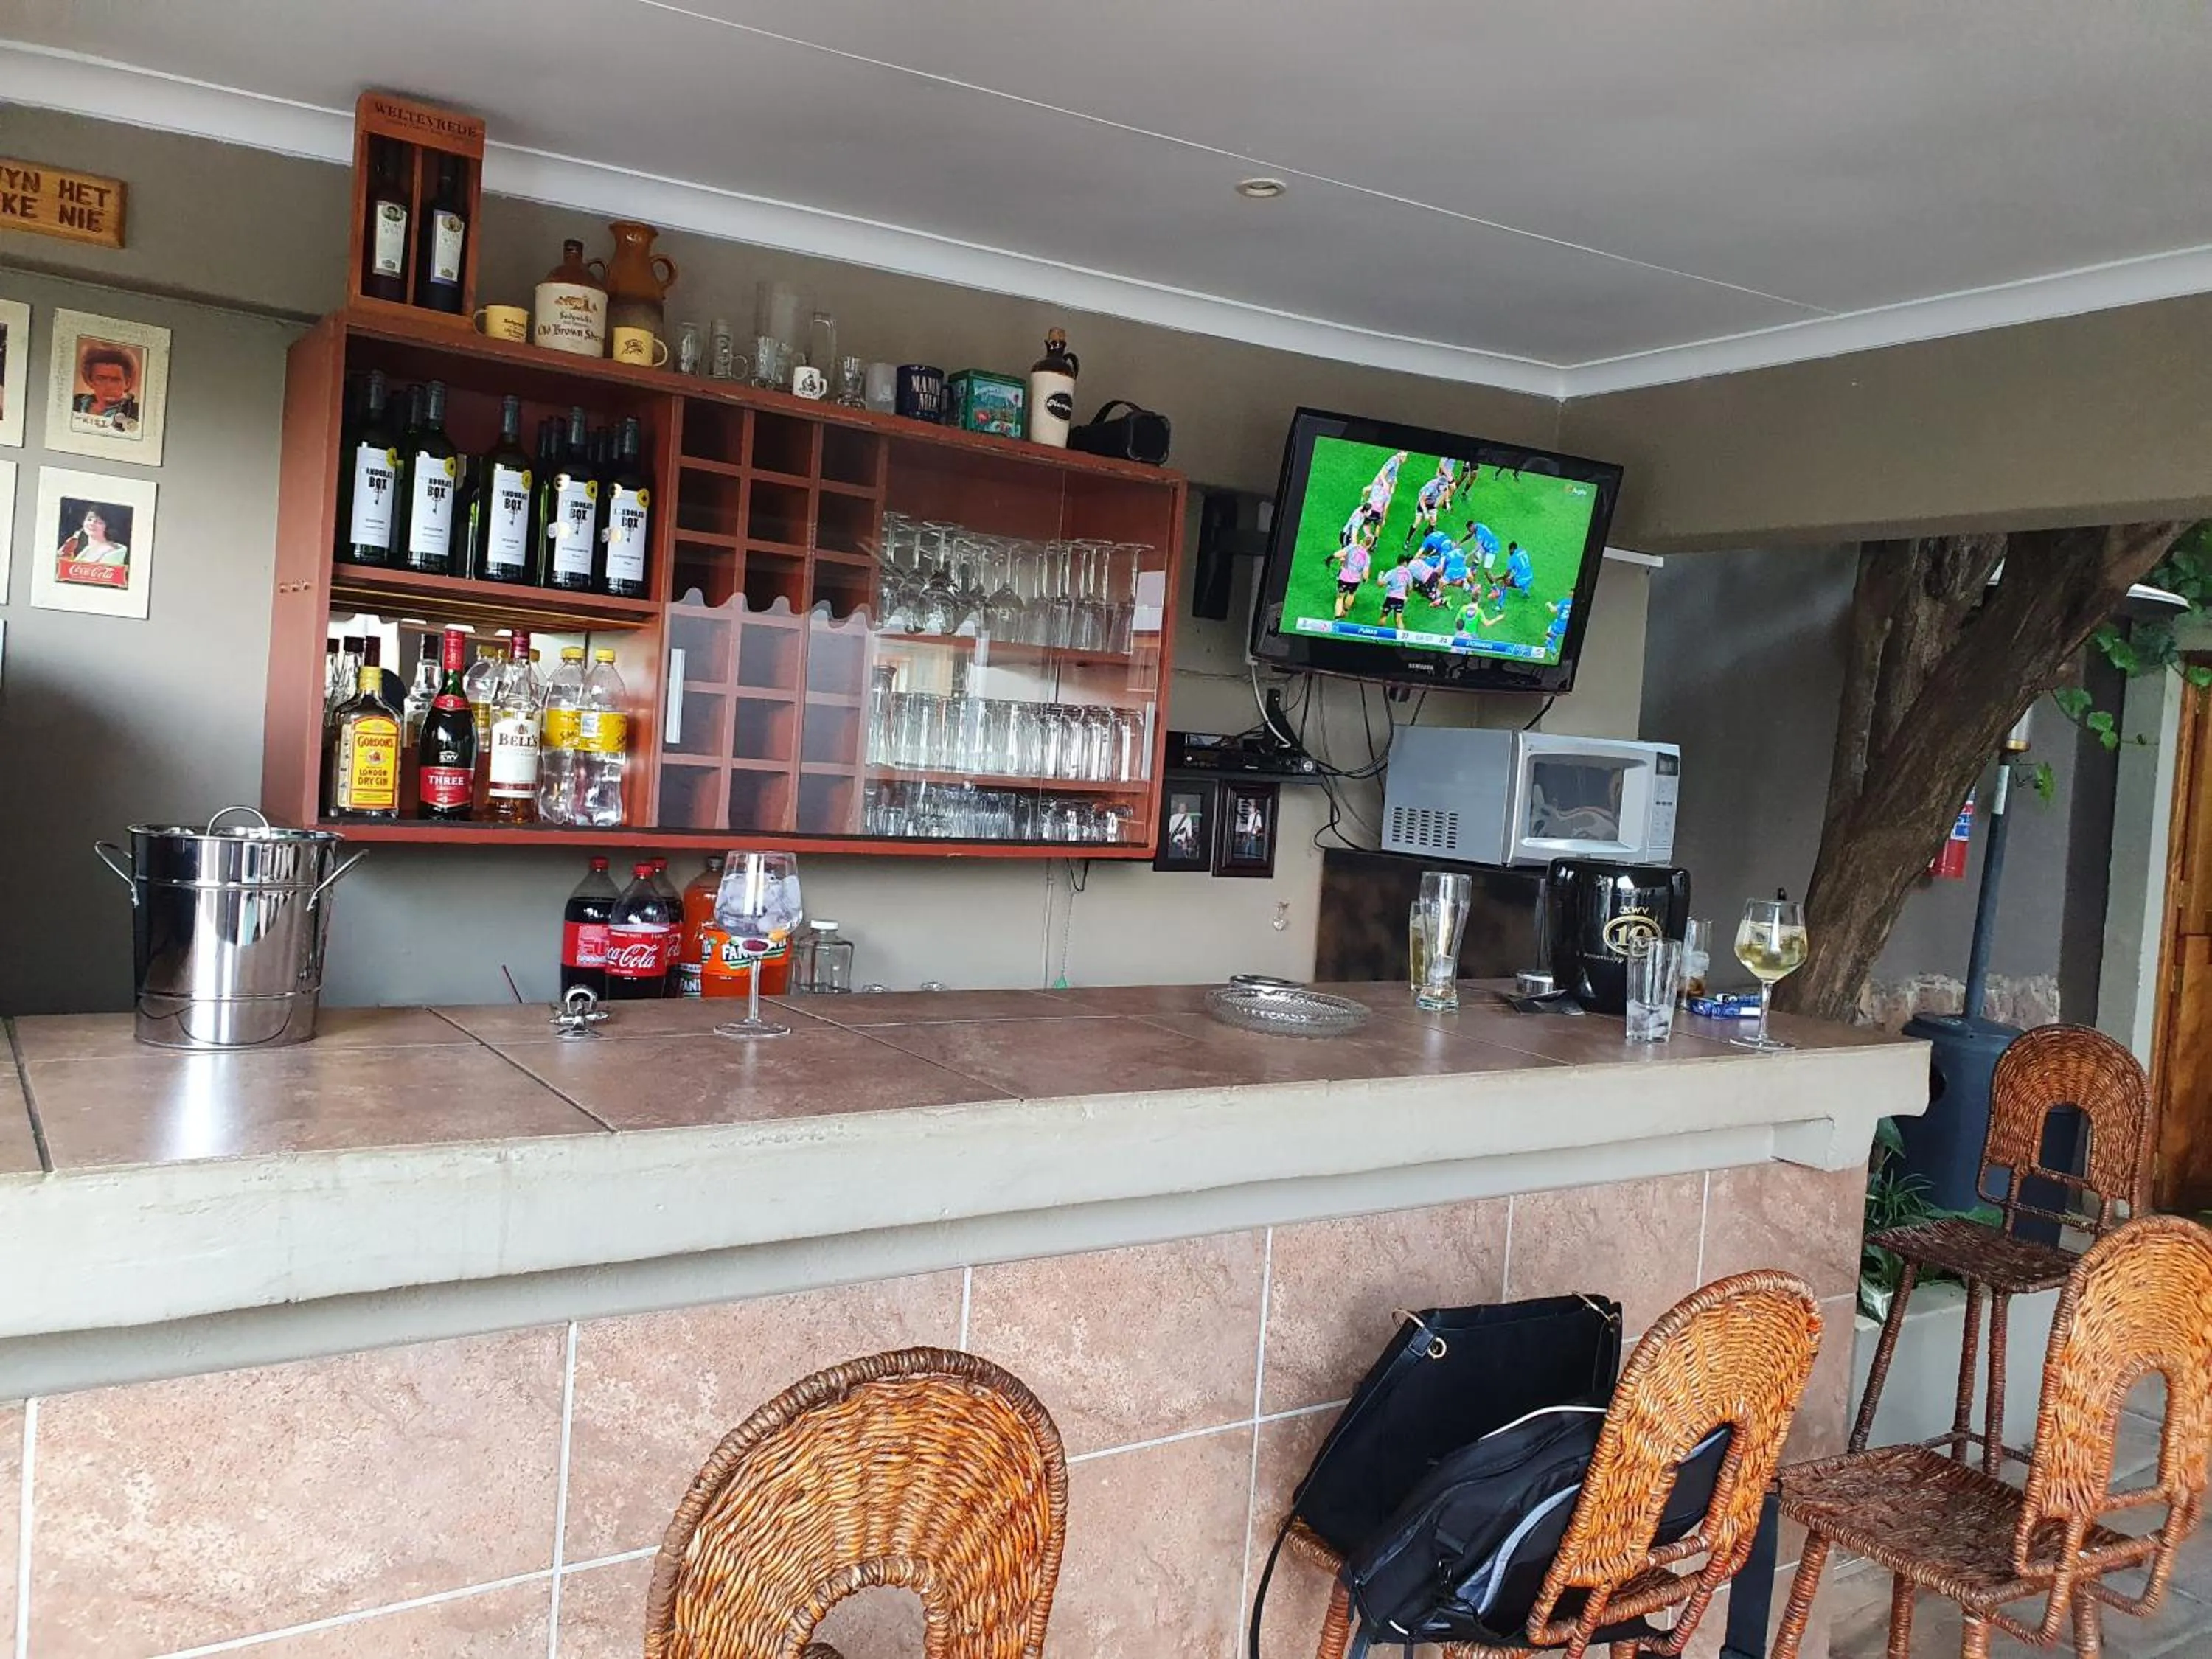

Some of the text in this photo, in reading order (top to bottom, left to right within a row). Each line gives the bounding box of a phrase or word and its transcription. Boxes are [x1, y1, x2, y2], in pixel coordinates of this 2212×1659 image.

[58, 178, 111, 207] HET
[58, 204, 105, 233] NIE
[369, 476, 387, 490] BOX
[427, 485, 445, 498] BOX
[504, 498, 522, 511] BOX
[358, 776, 373, 785] DRY
[428, 775, 465, 785] THREE
[721, 943, 750, 961] FAN
